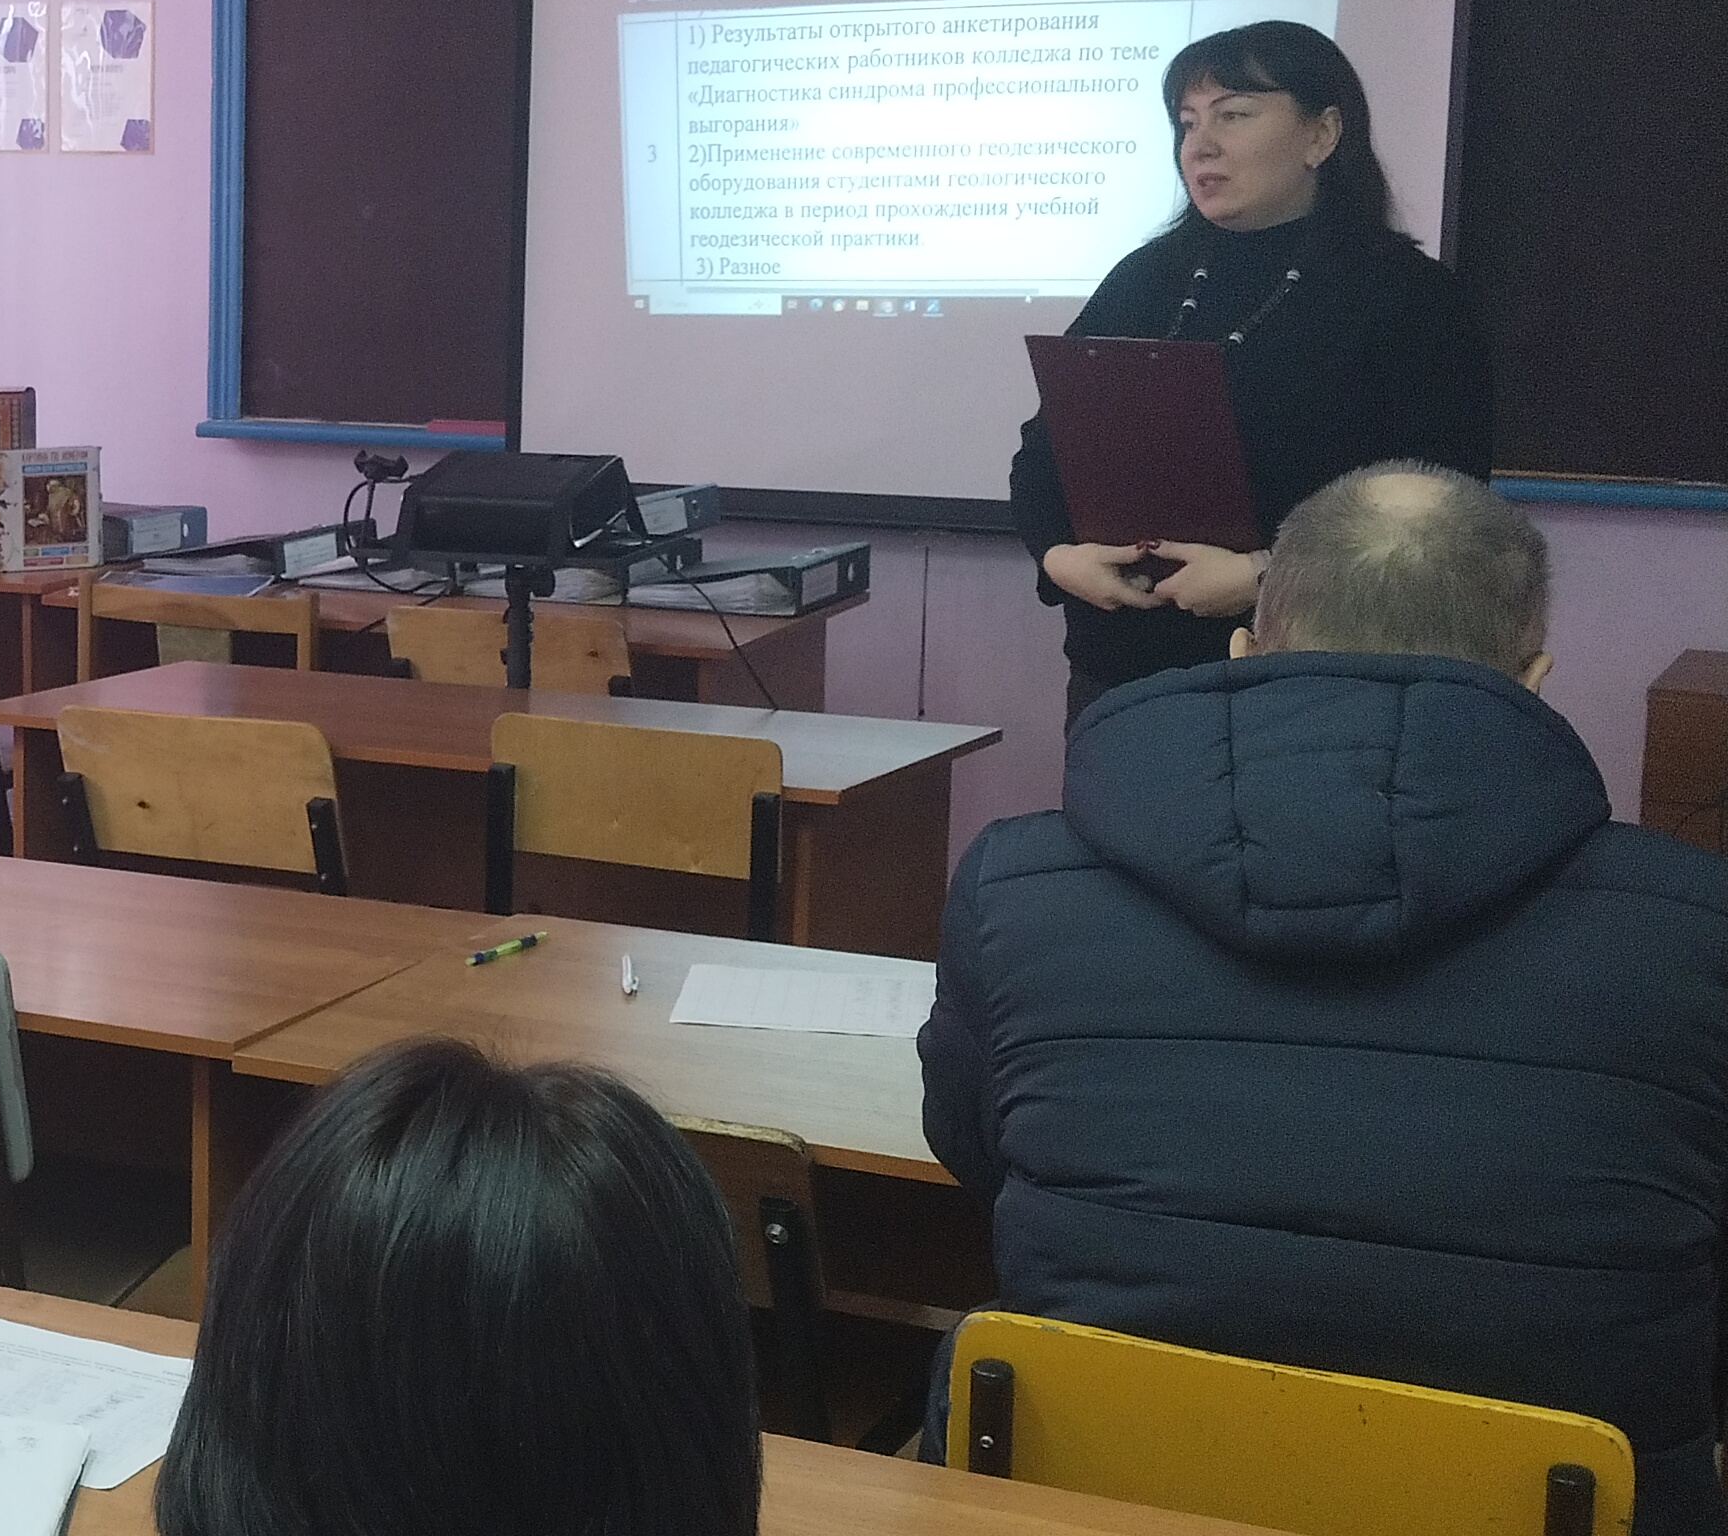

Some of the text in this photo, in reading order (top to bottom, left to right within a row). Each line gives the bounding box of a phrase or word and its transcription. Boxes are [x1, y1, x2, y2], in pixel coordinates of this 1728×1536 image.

[688, 15, 1099, 49] 1) Результаты открытого анкетирования
[687, 44, 1160, 75] педагогических работников колледжа по теме
[688, 76, 1139, 107] «Диагностика синдрома профессионального
[688, 117, 799, 137] выгорания»
[647, 144, 657, 163] 3
[832, 142, 971, 164] современного
[978, 139, 1137, 158] геодезического
[688, 171, 1106, 195] оборудования студентами геологического
[690, 197, 1099, 222] колледжа в период прохождения учебной
[690, 231, 823, 249] геодезической
[696, 256, 781, 279] 3) Разное
